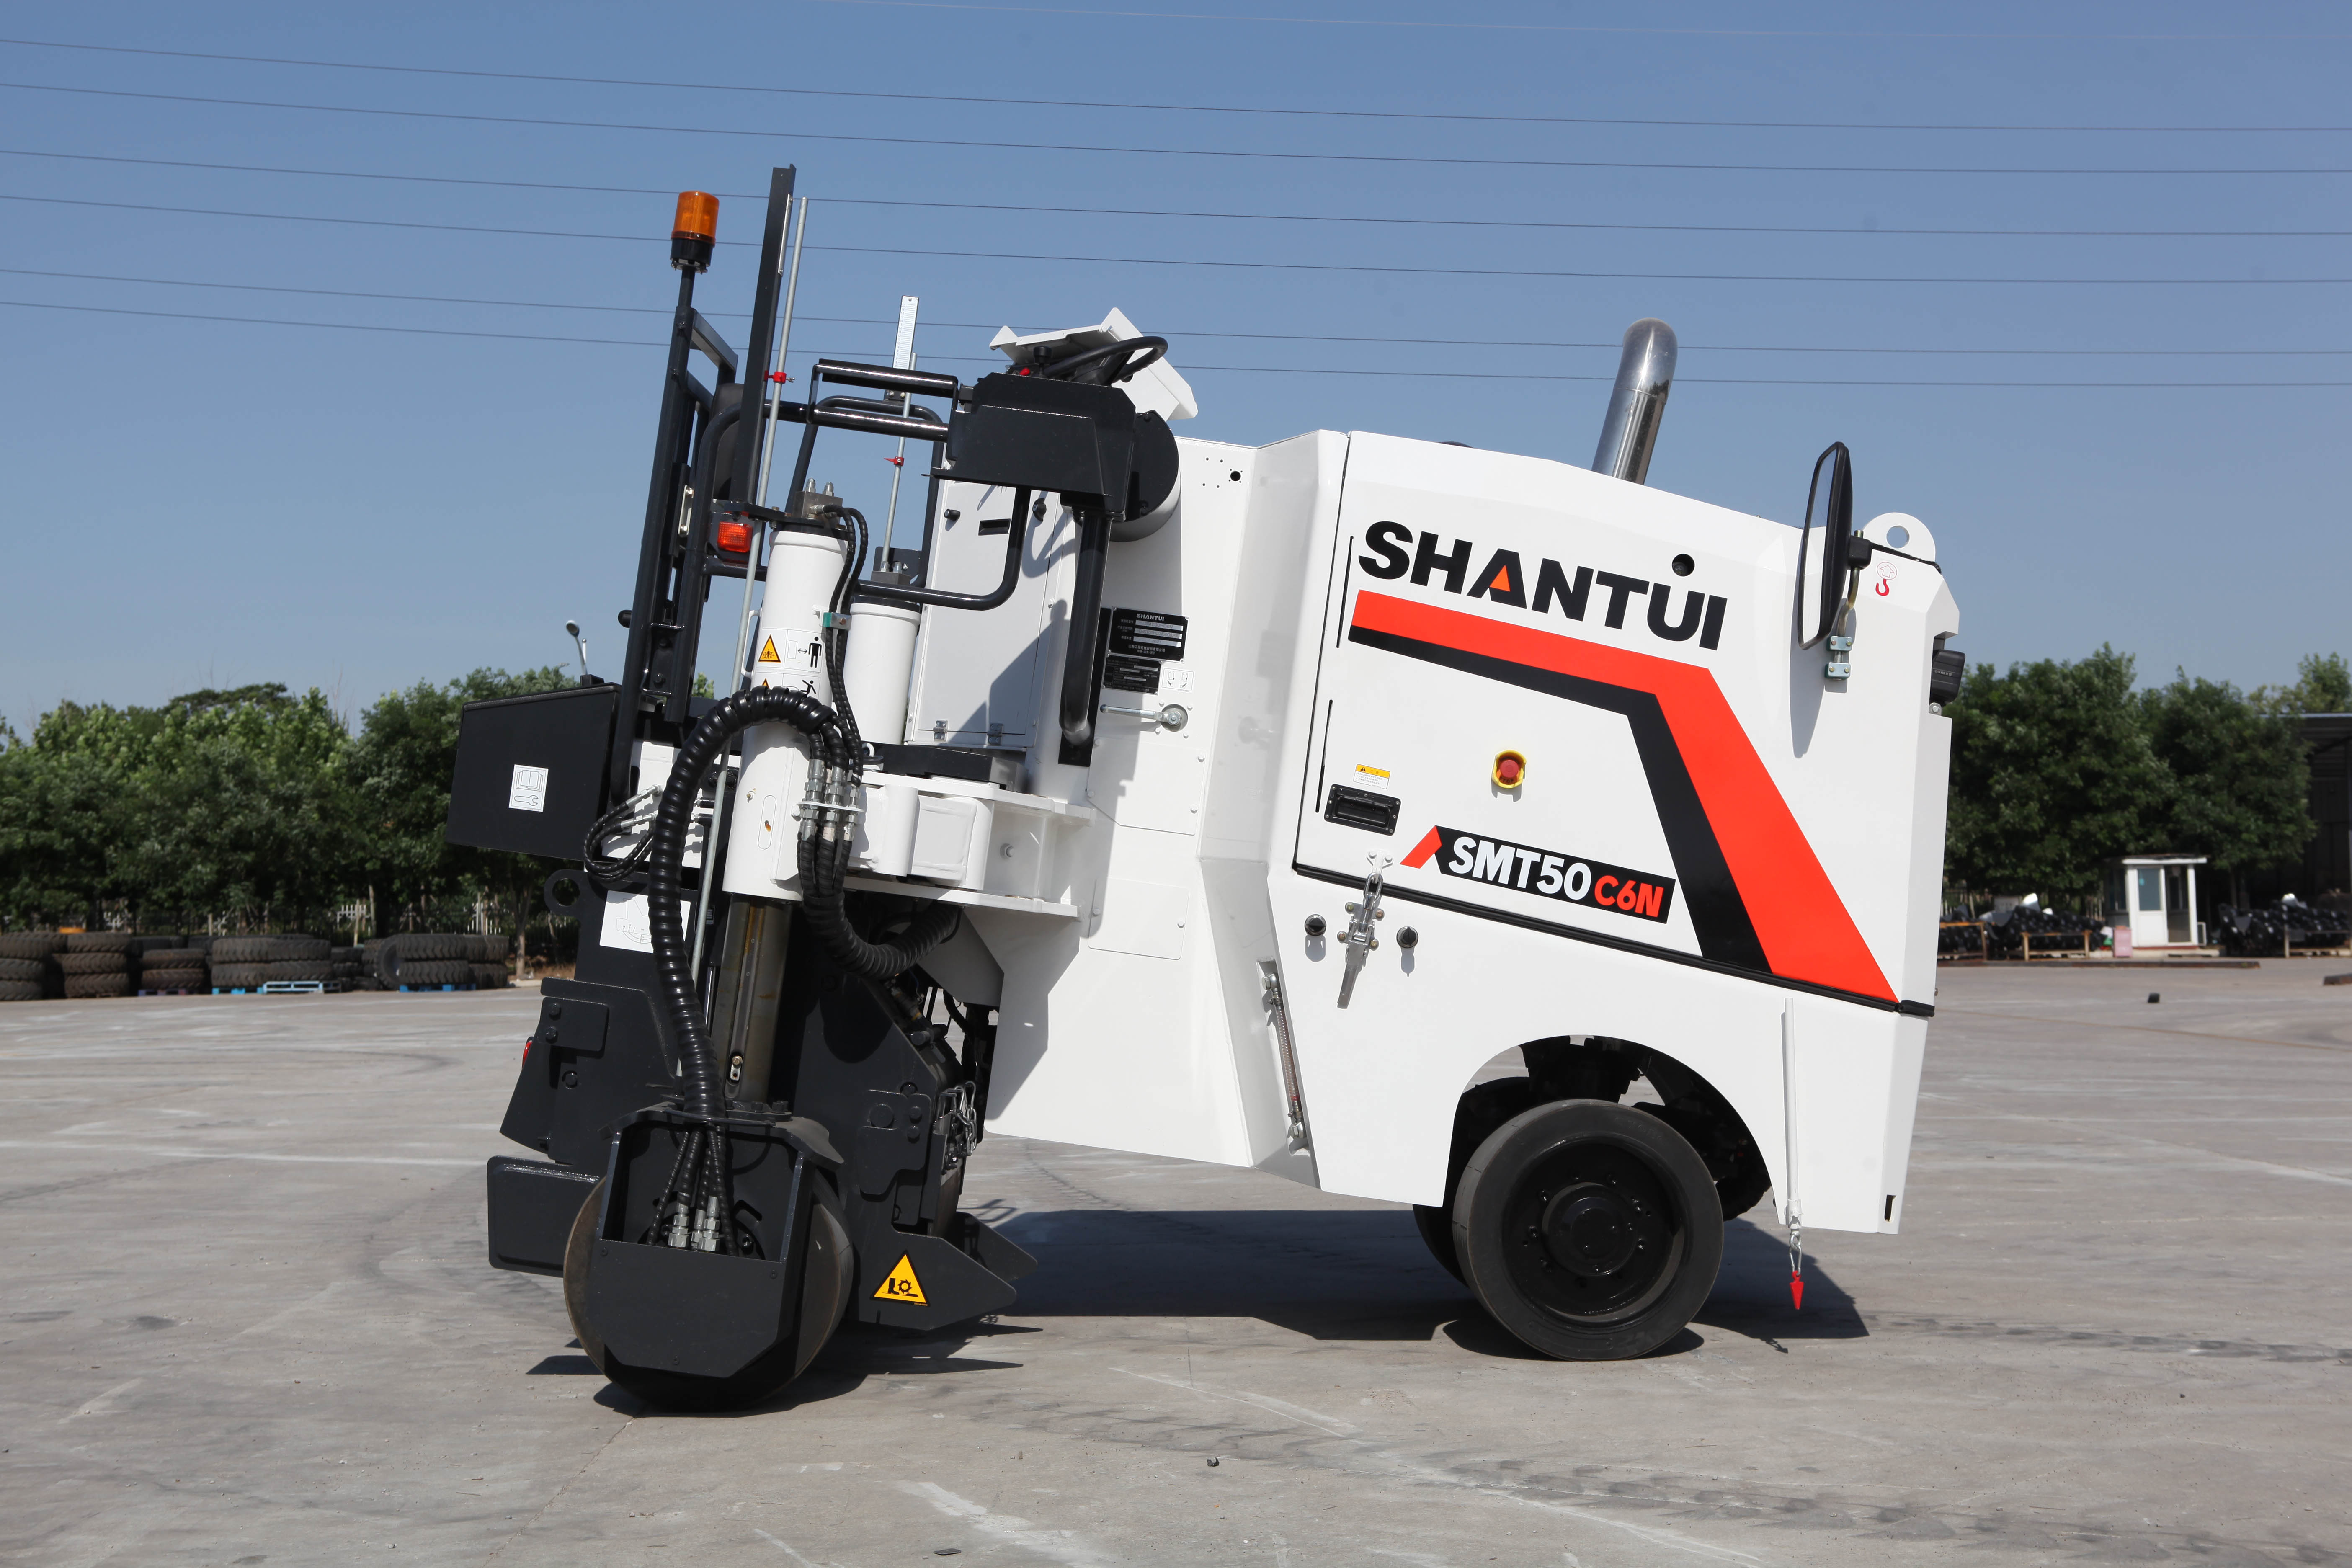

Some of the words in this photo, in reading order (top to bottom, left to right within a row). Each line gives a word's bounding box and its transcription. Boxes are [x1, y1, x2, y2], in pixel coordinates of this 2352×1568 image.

[1359, 521, 1728, 650] SHANTUI
[1449, 837, 1591, 900] SMT50
[1594, 875, 1663, 918] C6N
